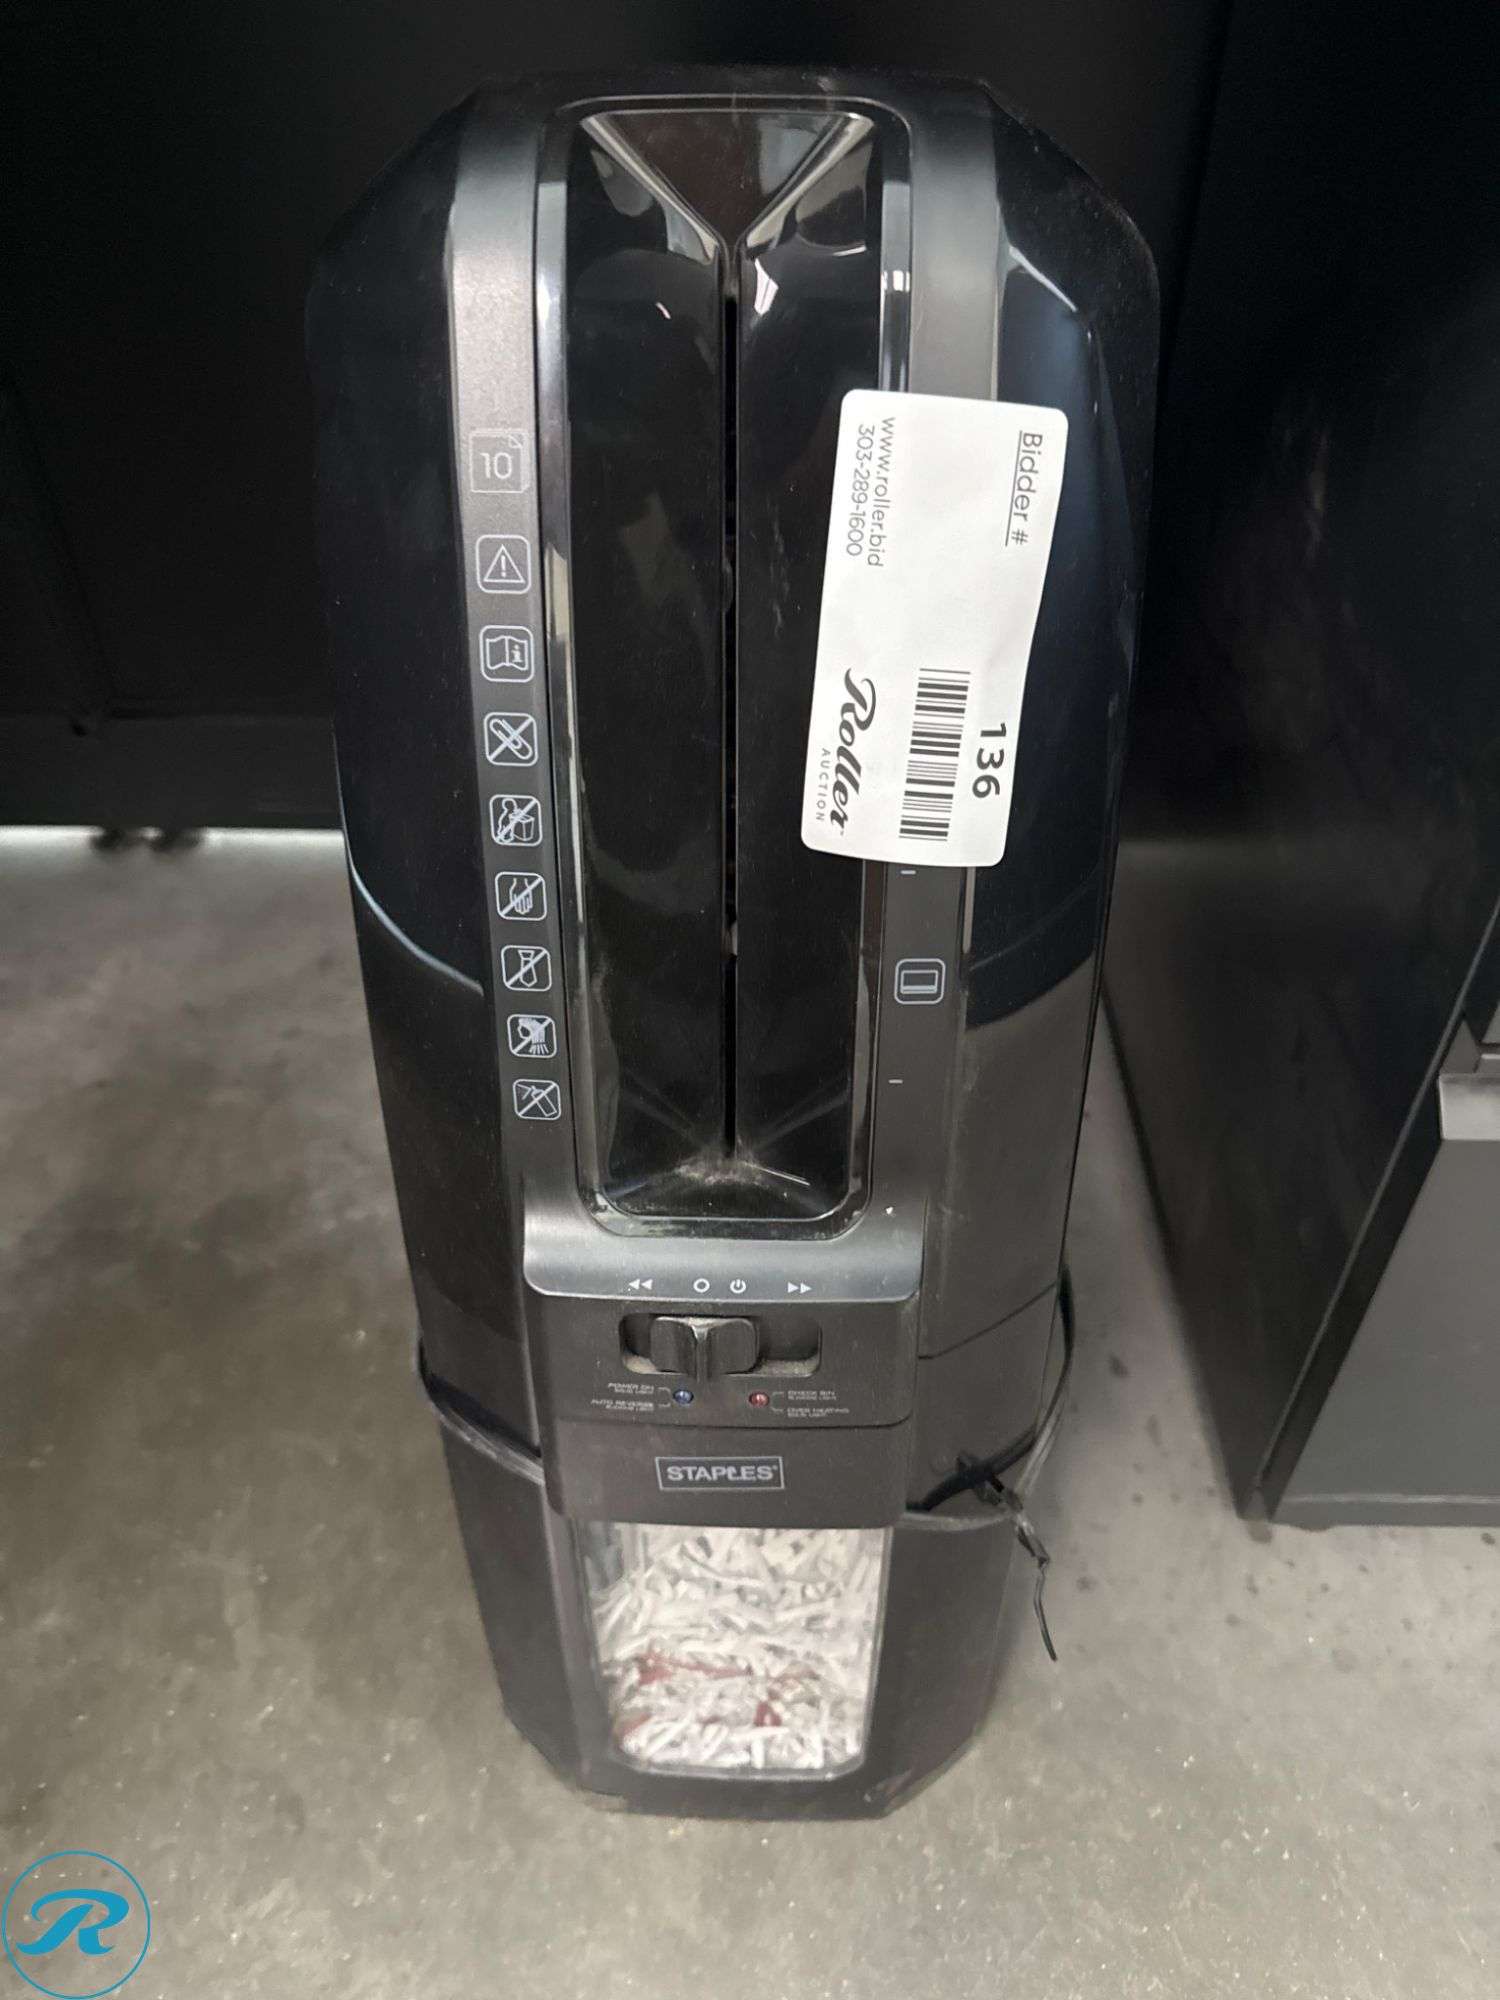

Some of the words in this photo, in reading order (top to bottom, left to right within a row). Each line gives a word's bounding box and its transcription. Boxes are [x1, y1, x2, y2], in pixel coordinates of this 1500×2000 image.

[481, 451, 512, 480] 10
[846, 423, 875, 557] 303-289-1600
[867, 416, 896, 567] www.roller.bid
[1013, 431, 1044, 522] Bidder
[1011, 529, 1029, 546] #
[815, 747, 831, 821] AUCTION
[830, 667, 877, 830] Roller
[972, 722, 1007, 799] 136
[667, 1465, 774, 1481] STAPLES
